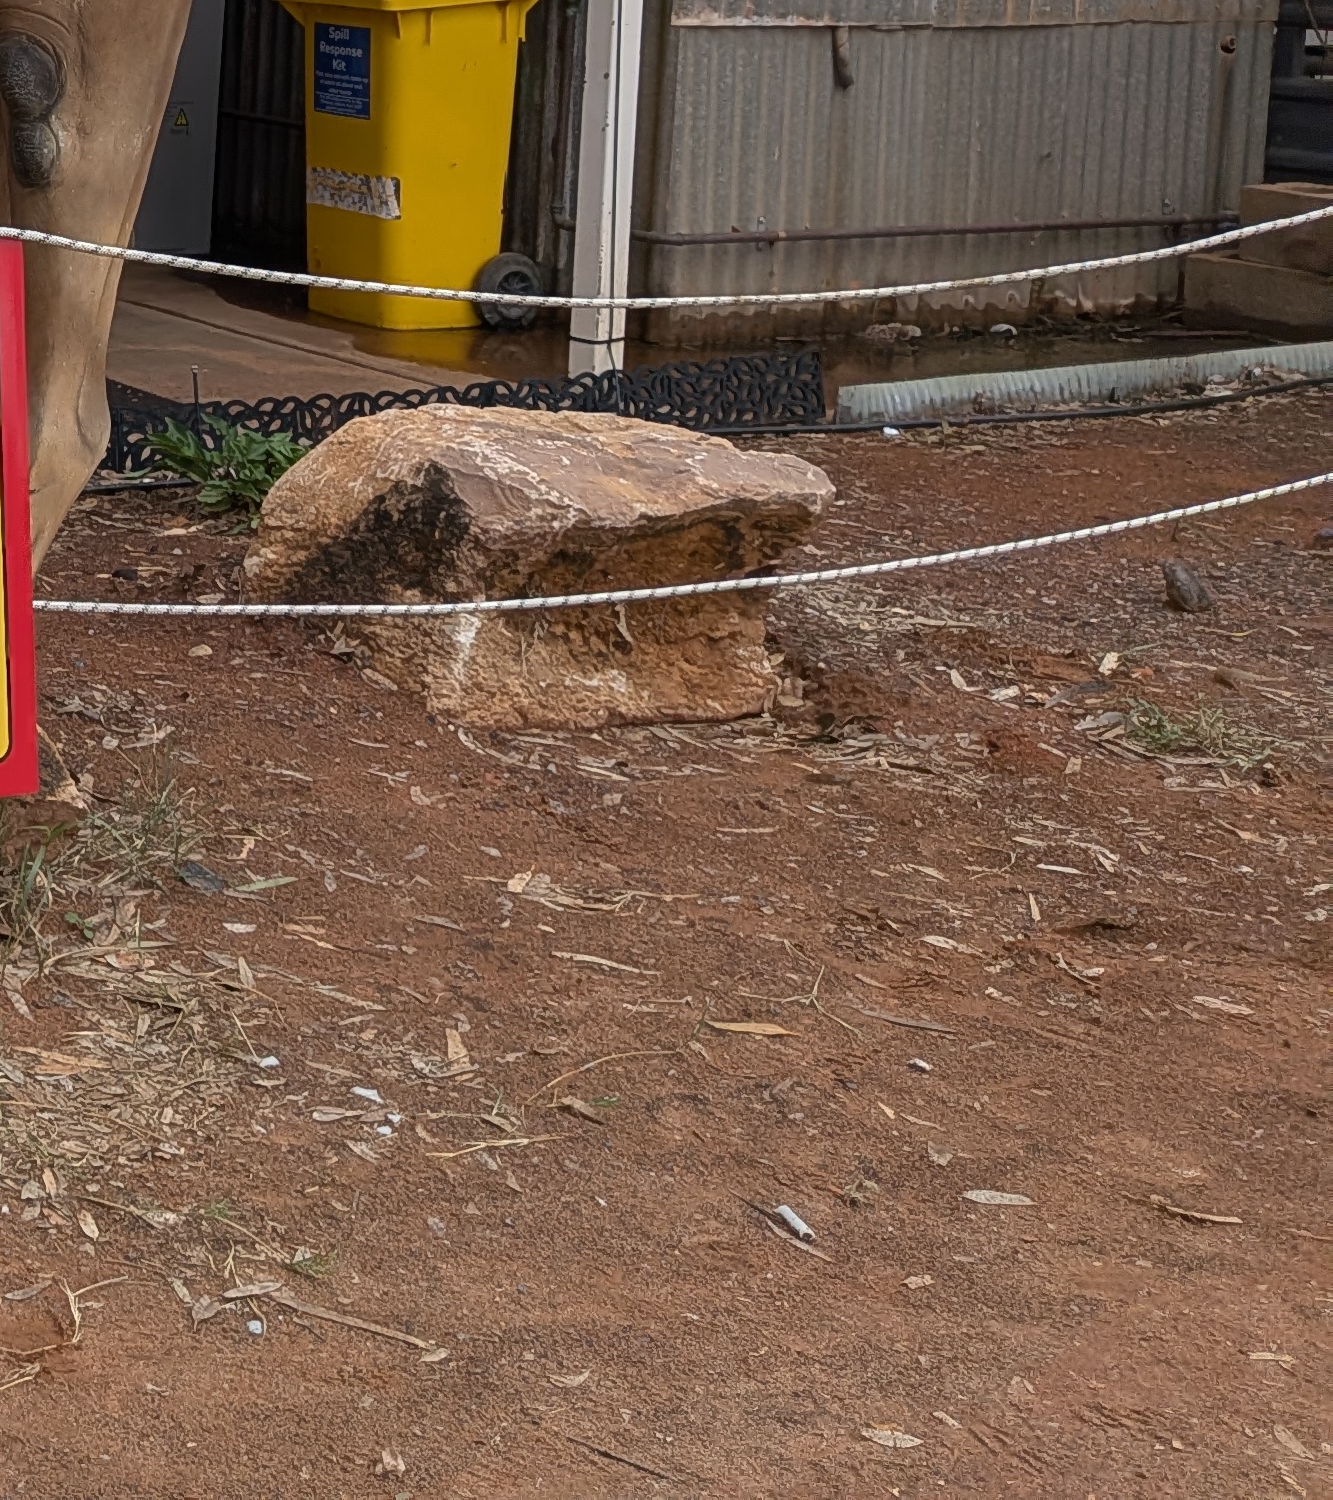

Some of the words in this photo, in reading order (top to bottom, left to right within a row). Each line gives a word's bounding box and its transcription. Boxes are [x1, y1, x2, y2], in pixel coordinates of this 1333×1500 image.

[328, 26, 350, 41] Spill
[319, 40, 363, 58] Response
[332, 58, 346, 71] Kit
